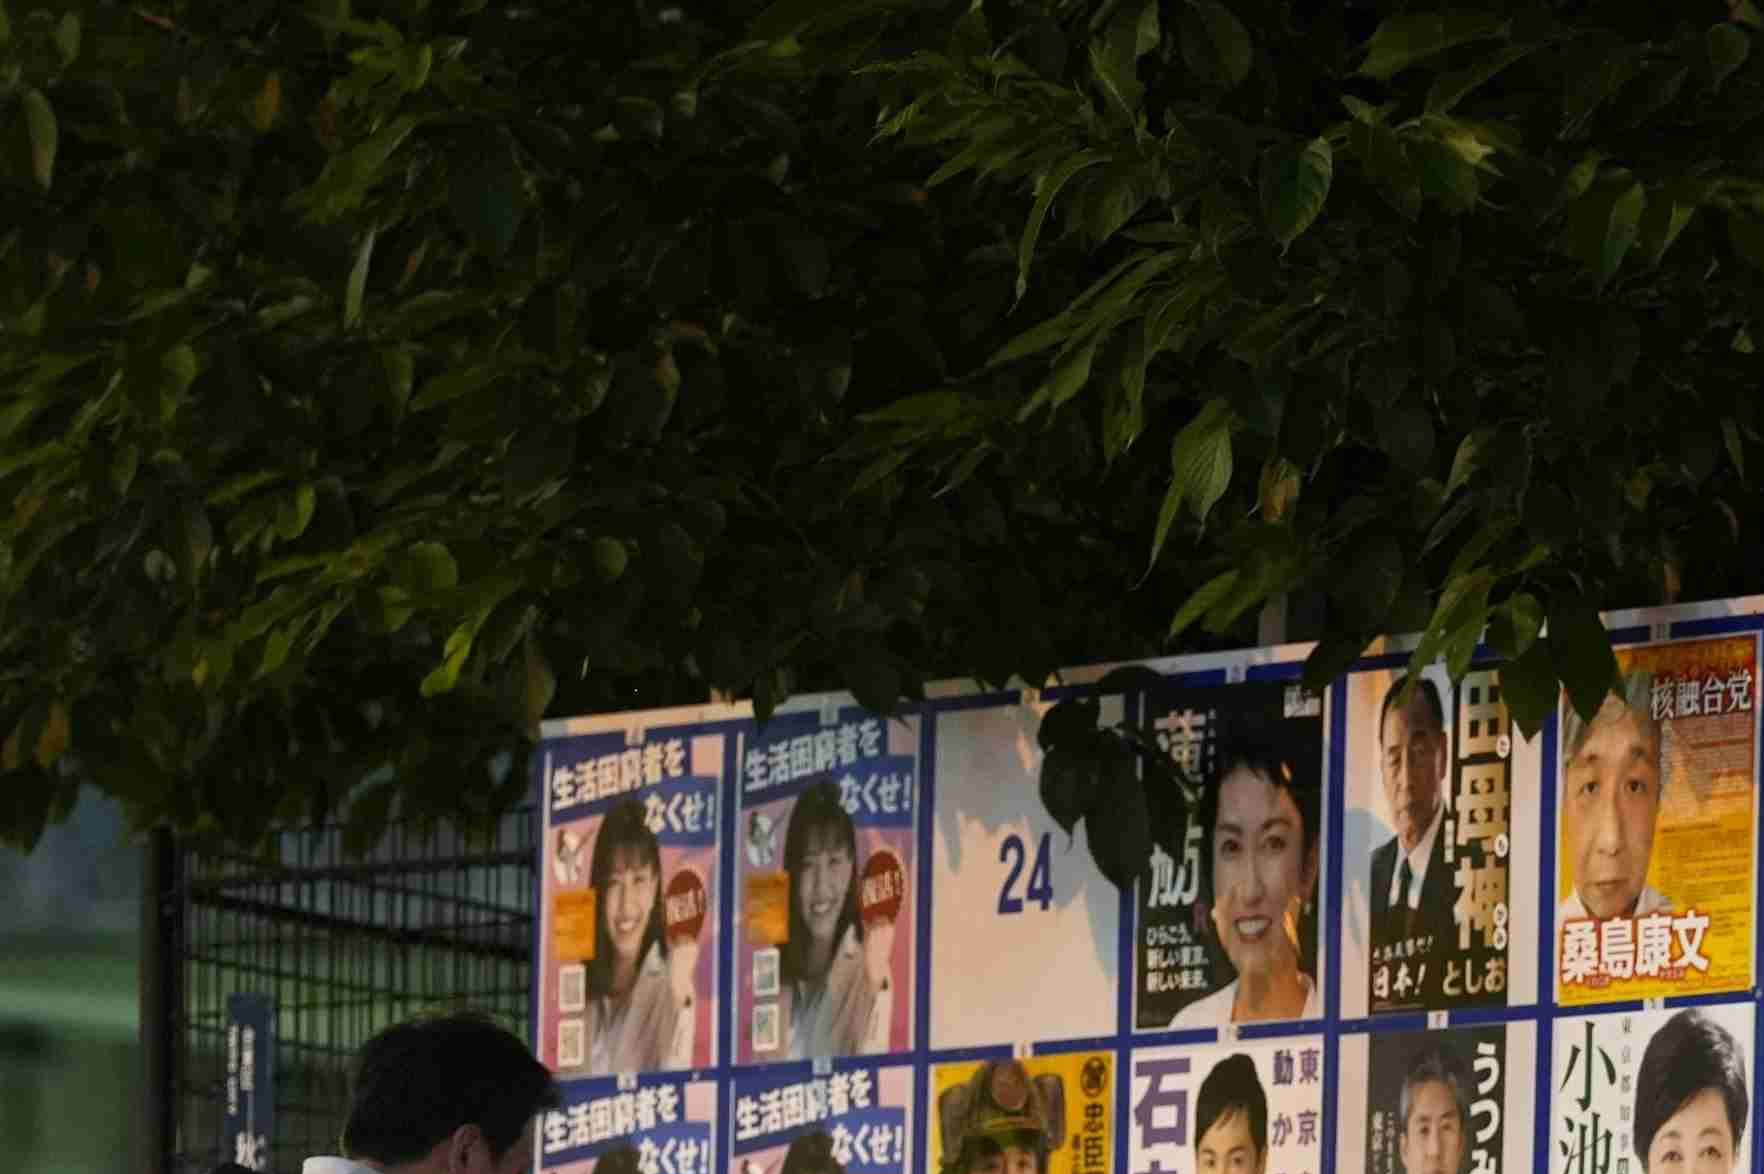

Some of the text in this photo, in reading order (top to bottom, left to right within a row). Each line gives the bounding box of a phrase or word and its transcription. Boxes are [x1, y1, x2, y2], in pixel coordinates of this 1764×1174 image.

[1453, 667, 1509, 950] 田母神
[996, 831, 1054, 916] 24
[1372, 961, 1428, 999] 日本!
[1442, 957, 1506, 997] としお
[1561, 909, 1711, 985] 桑島康文
